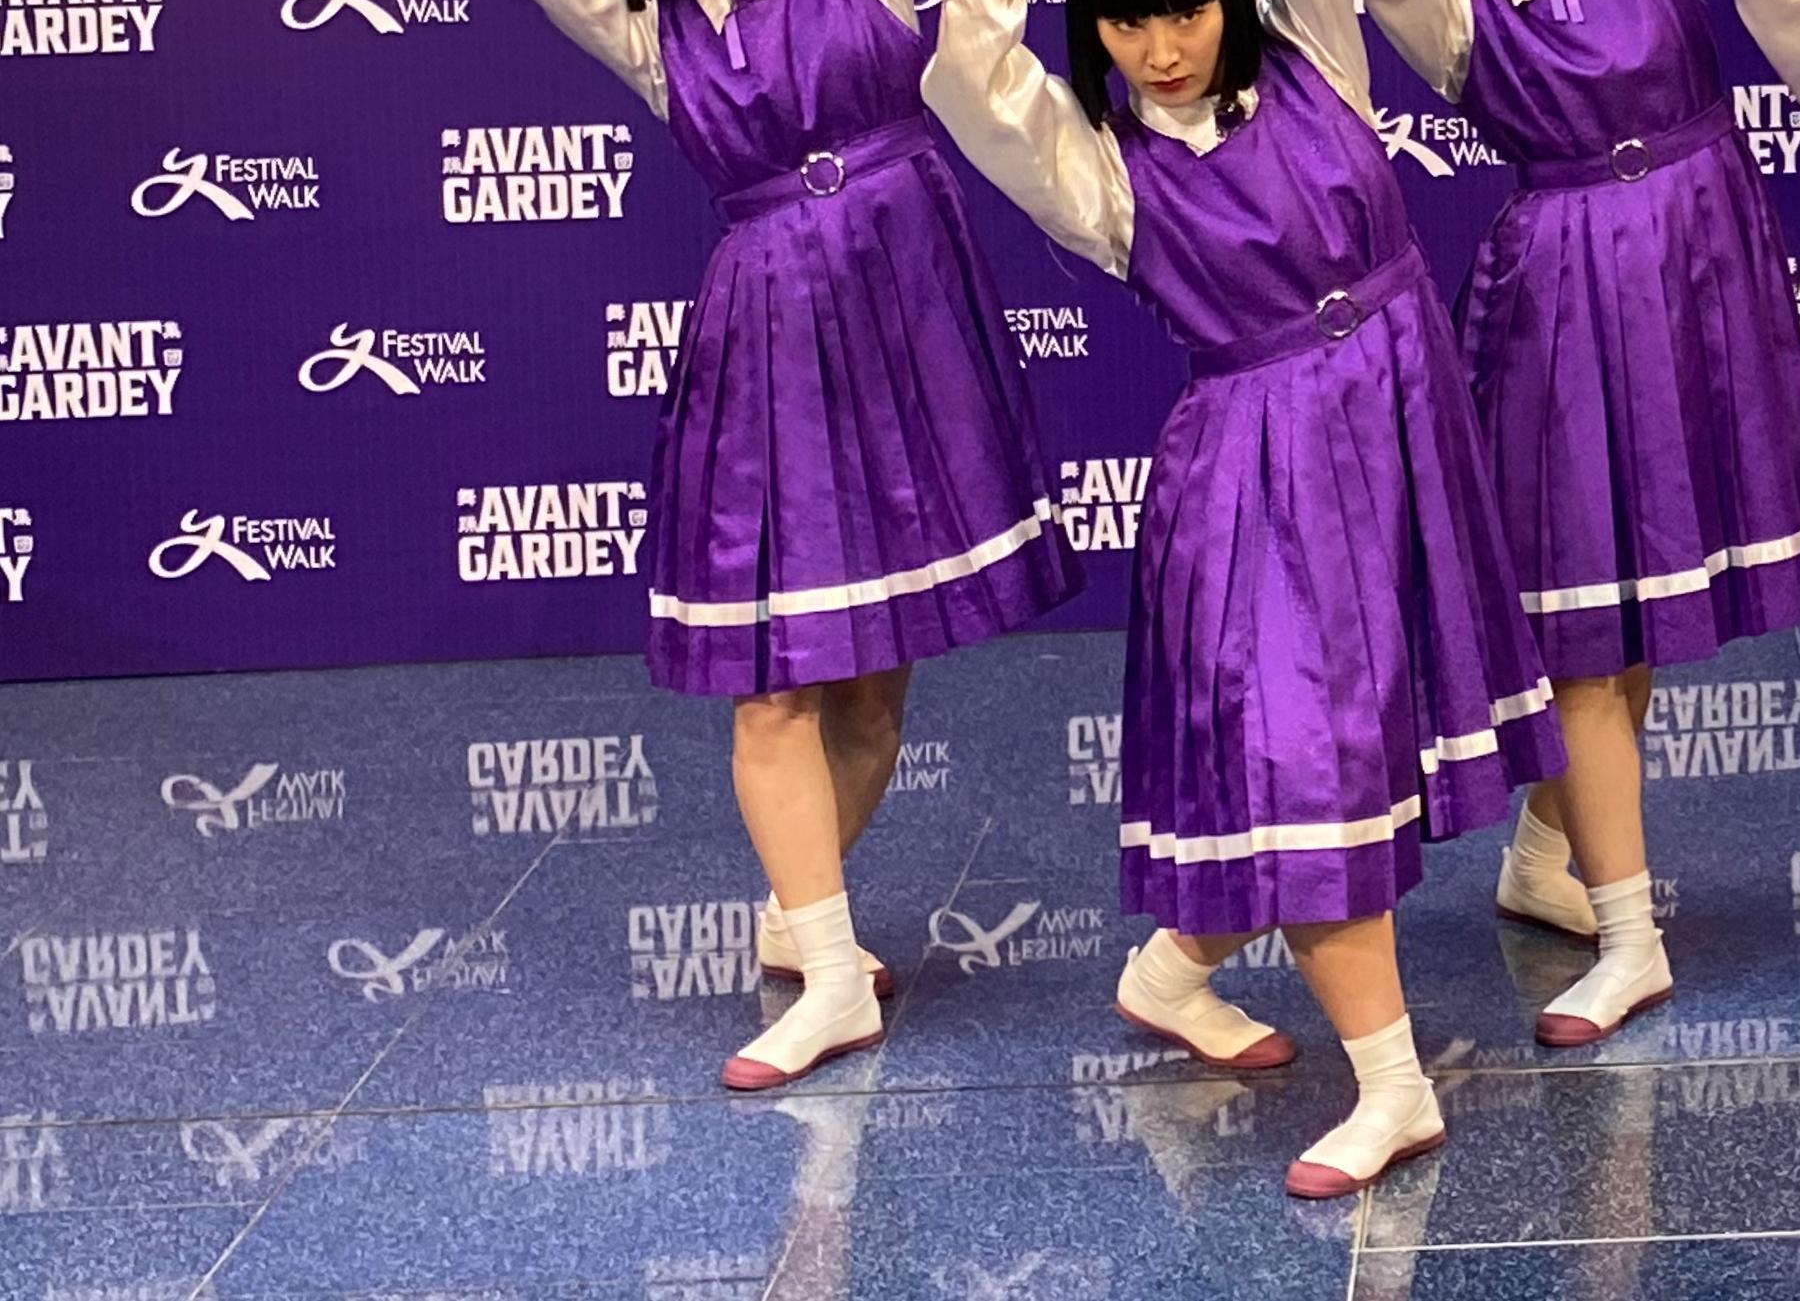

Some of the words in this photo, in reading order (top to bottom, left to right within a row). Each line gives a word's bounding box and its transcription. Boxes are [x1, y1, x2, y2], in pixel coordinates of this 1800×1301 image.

[0, 5, 163, 56] ARDEY
[464, 123, 614, 174] AVANT
[216, 155, 317, 183] FESTIVAL
[246, 184, 318, 210] WALK
[444, 171, 630, 224] GARDEY
[1004, 306, 1089, 332] ESTIVAL
[10, 320, 162, 372] AVANT
[383, 329, 483, 357] FESTIVAL
[1019, 332, 1089, 358] WALK
[413, 358, 484, 384] WALK
[479, 481, 627, 532] AVANT
[233, 516, 334, 543] FESTIVAL
[263, 544, 335, 570] WALK
[458, 528, 644, 581] GARDEY
